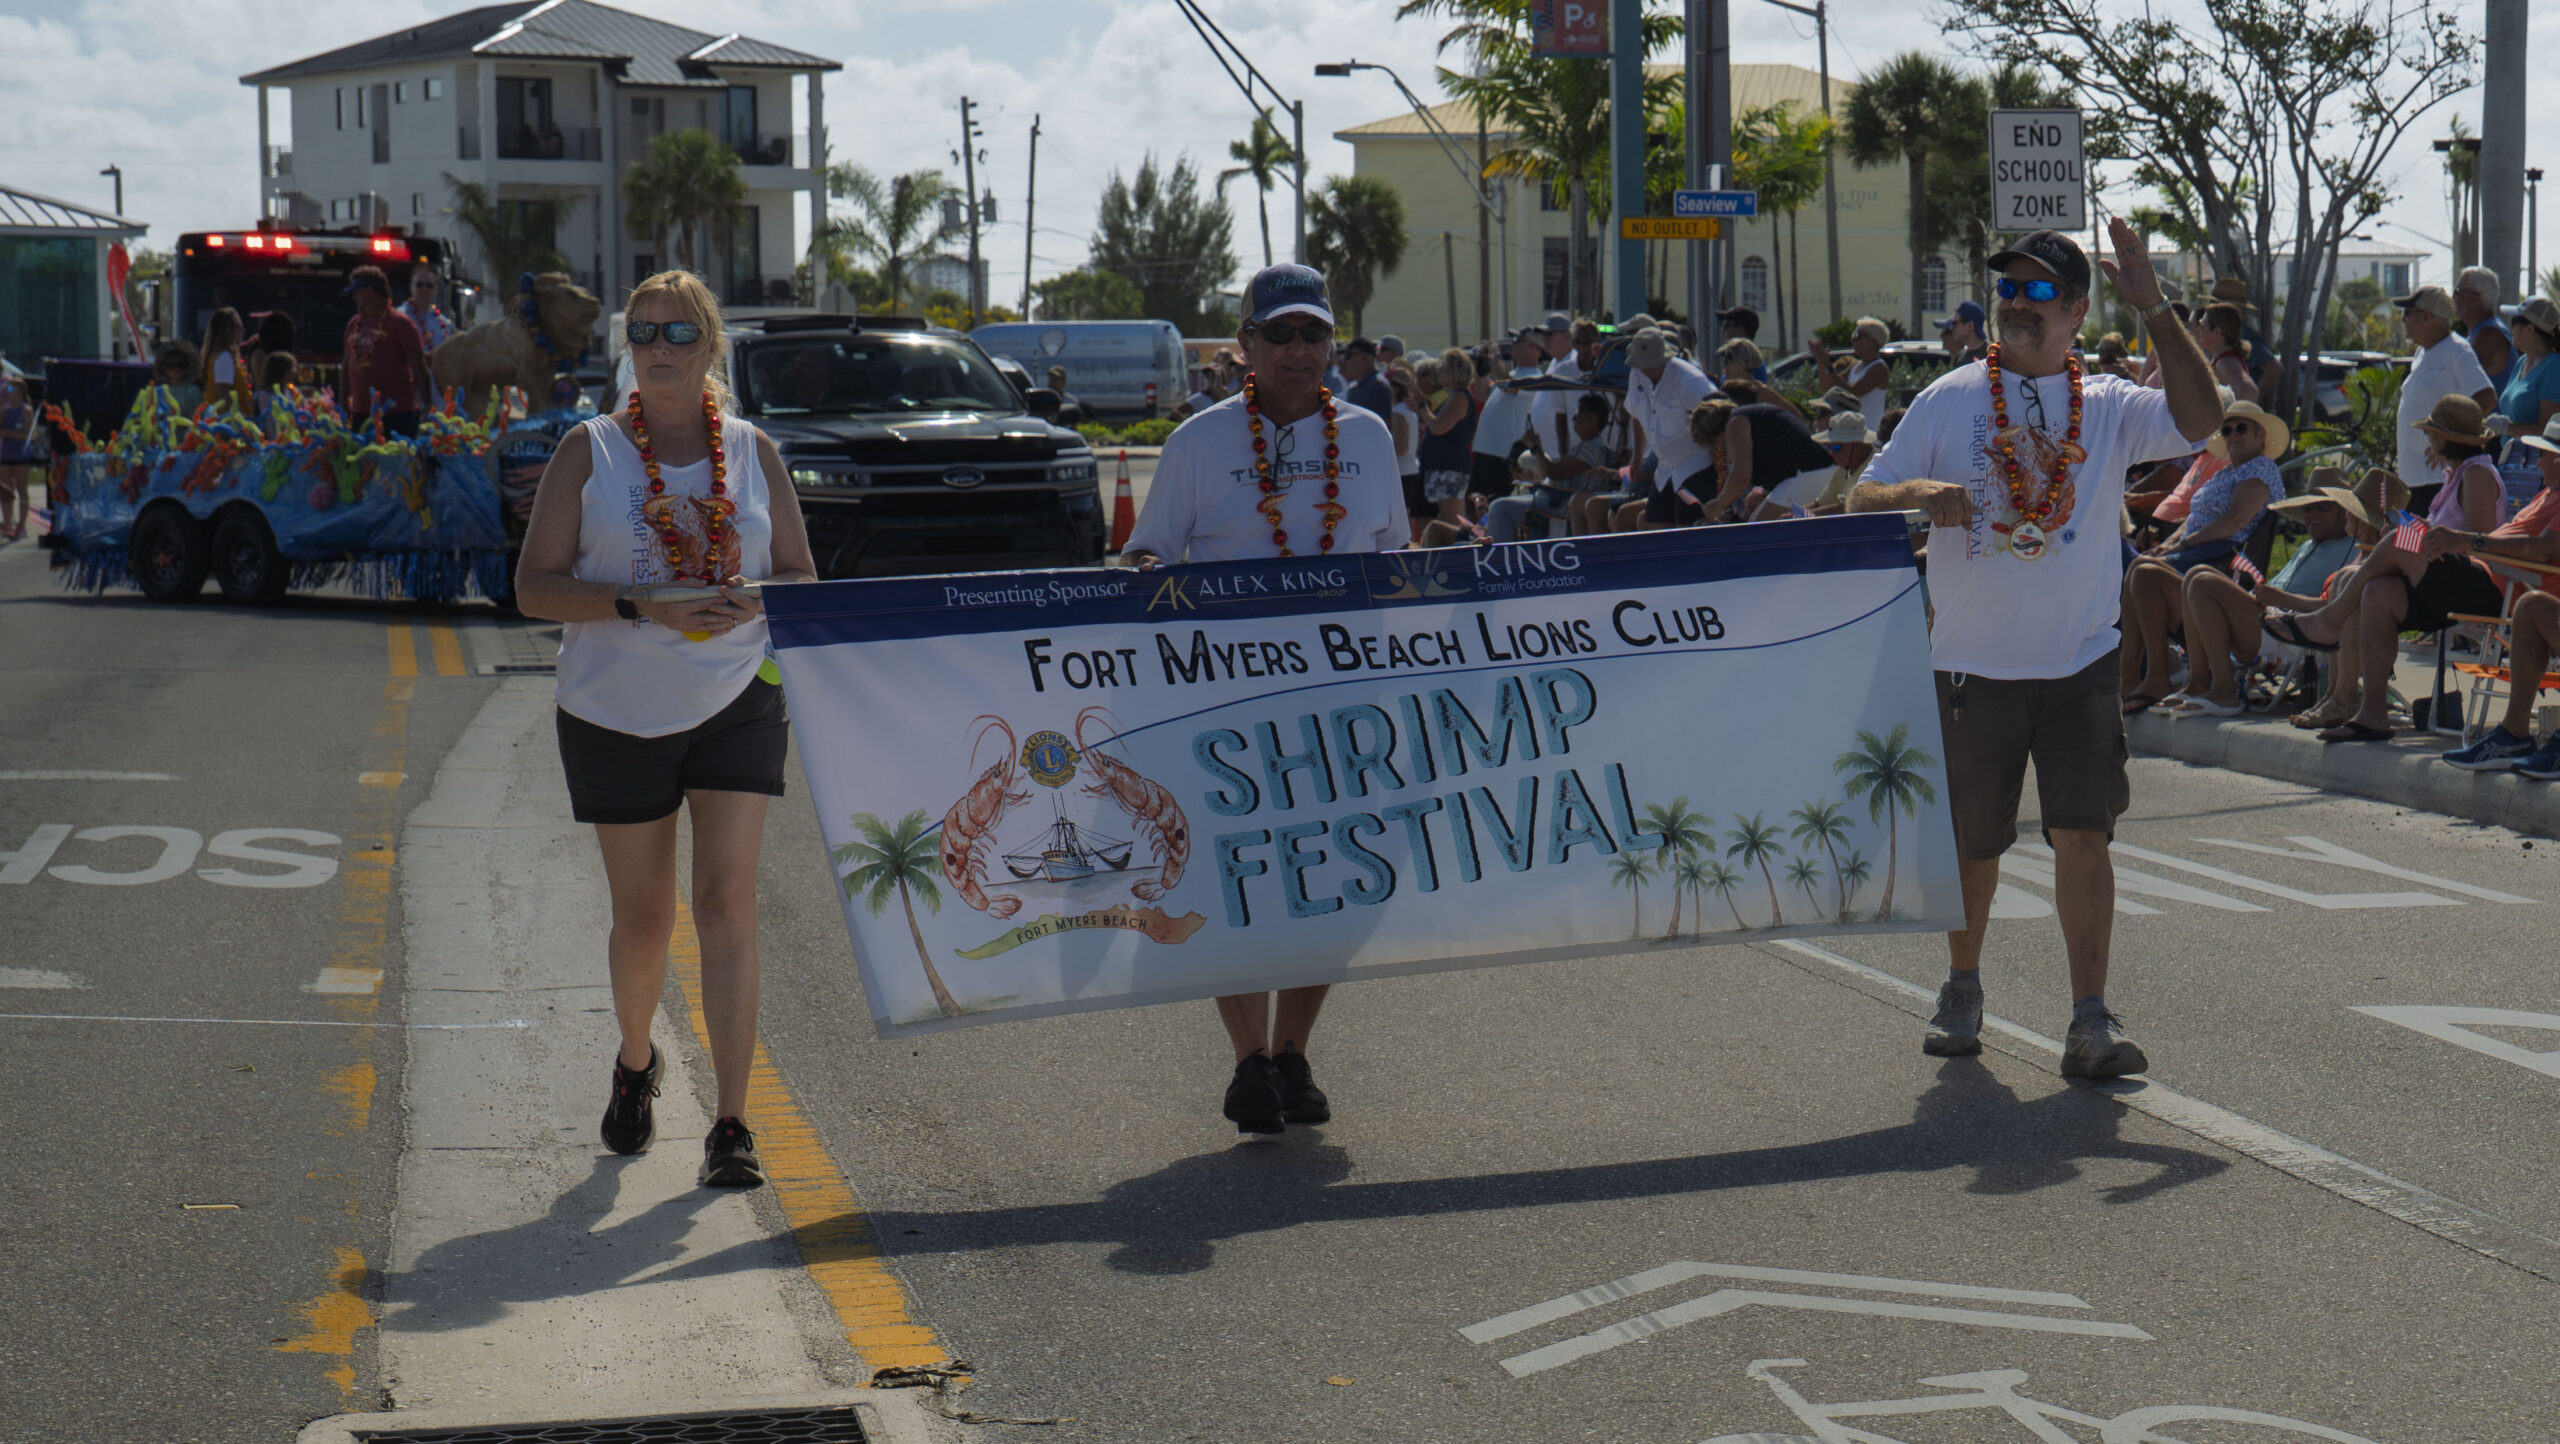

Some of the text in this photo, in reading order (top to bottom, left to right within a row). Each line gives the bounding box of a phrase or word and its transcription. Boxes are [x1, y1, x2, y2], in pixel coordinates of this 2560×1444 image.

[1564, 3, 1584, 29] P
[2014, 125, 2062, 147] END
[1998, 159, 2080, 182] SCHOOL
[1678, 194, 1738, 212] Seaview
[2012, 195, 2068, 217] ZONE
[1632, 221, 1700, 235] NO OUTLET
[1269, 274, 1317, 292] Beach
[1969, 414, 1988, 472] SHRIMP
[627, 484, 648, 542] SHRIMP
[1473, 542, 1581, 578] KING
[943, 580, 1127, 607] Presenting Sponsor
[1199, 575, 1268, 596] ALEX
[1281, 569, 1346, 591] KING
[1317, 588, 1348, 599] GROUP
[1478, 575, 1586, 594] Family Foundation
[1024, 599, 1725, 692] FORT MYERS BEACH LIONS CLUB
[1028, 732, 1064, 747] LIONS
[1192, 667, 1597, 817] SHRIMP
[1042, 748, 1061, 769] L
[1213, 762, 1668, 927] FESTIVAL
[1016, 915, 1147, 945] FORT MYERS BEACH
